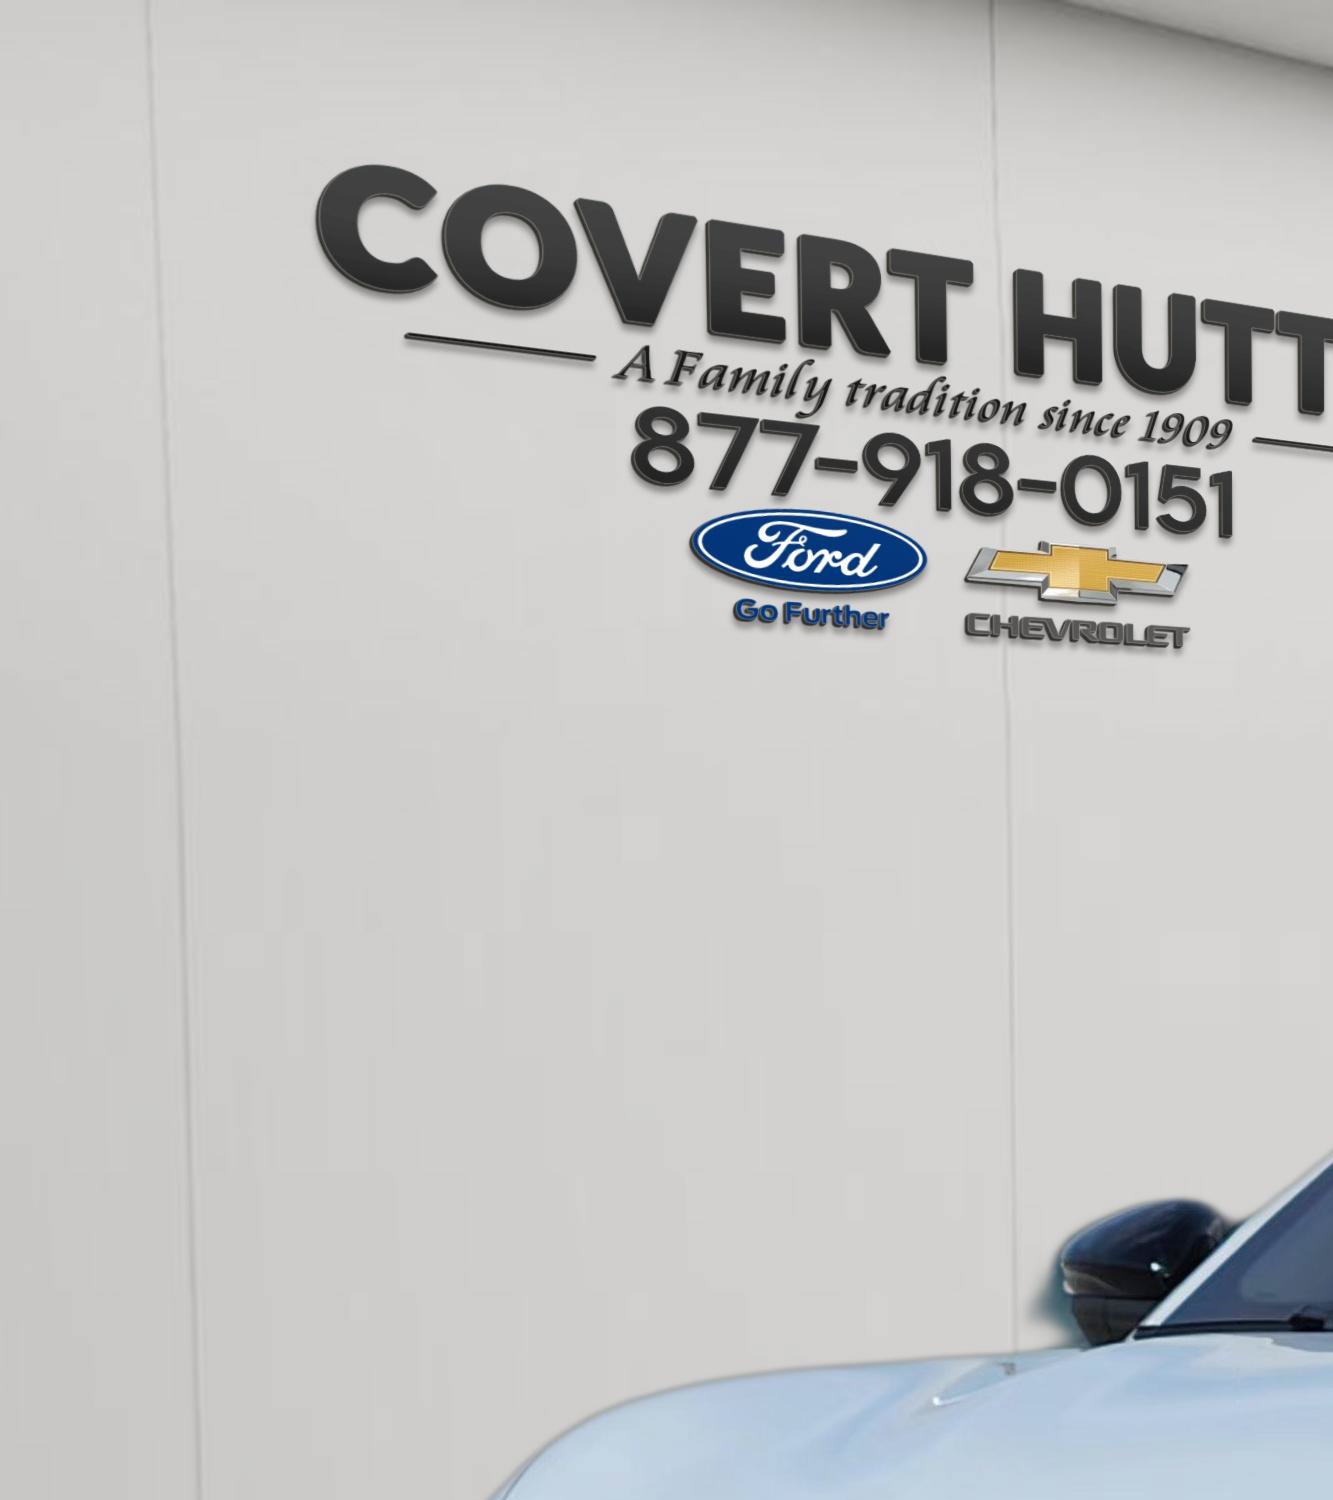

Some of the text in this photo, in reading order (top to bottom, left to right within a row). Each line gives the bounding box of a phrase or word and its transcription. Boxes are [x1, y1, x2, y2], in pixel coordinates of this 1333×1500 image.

[315, 163, 975, 367] COVERT
[612, 344, 1235, 451] A Family tradition since 1909
[630, 405, 1233, 539] 877-918-0151
[743, 520, 881, 578] Ford
[732, 598, 890, 631] Go Further
[964, 612, 1191, 650] CHEVROLET
